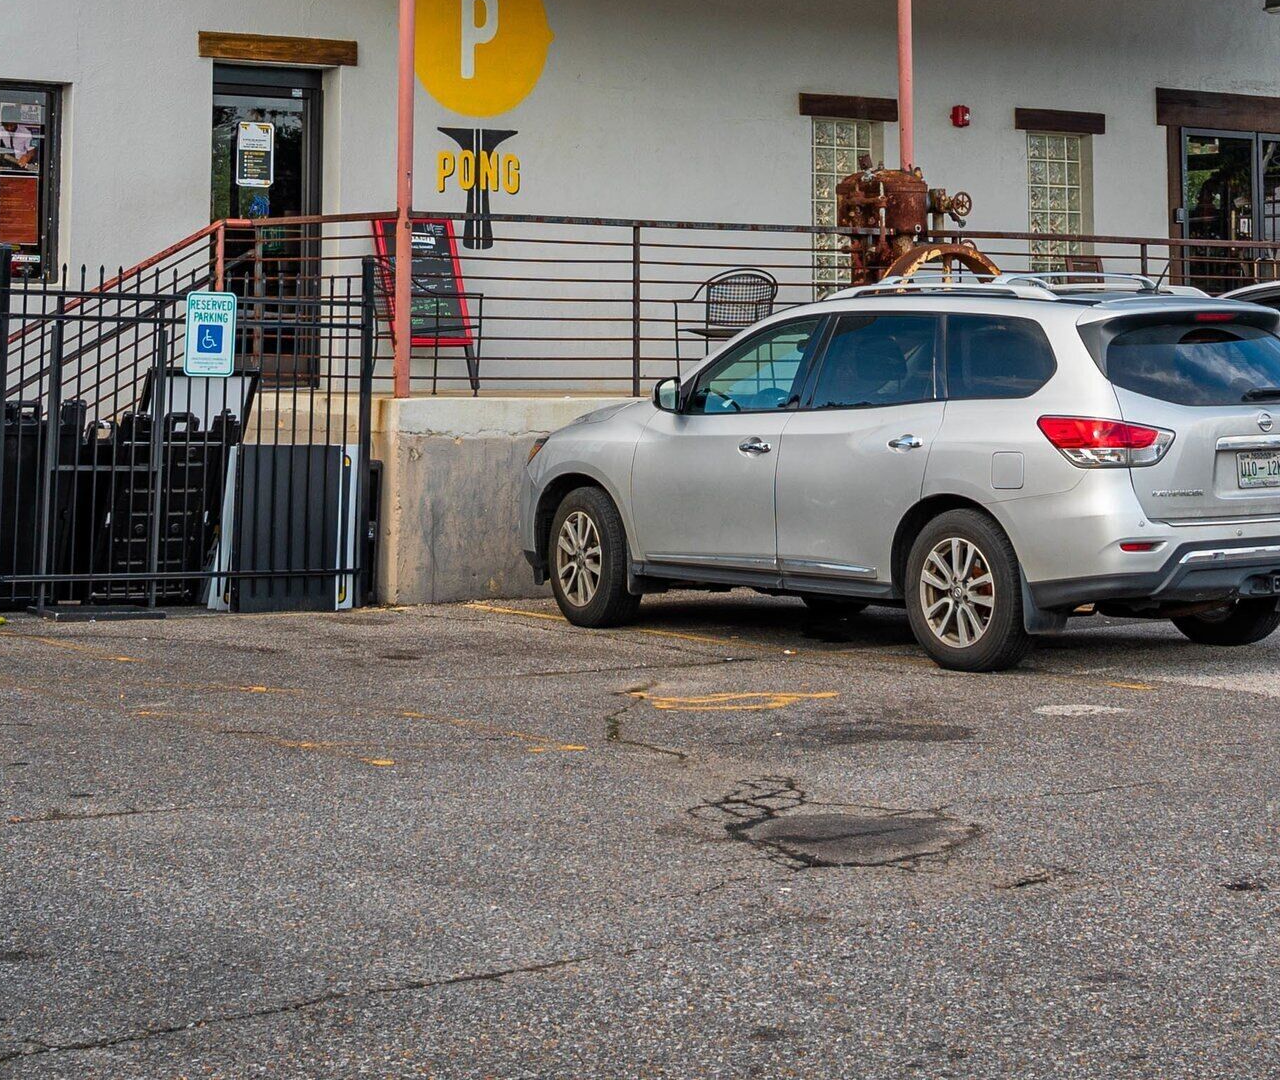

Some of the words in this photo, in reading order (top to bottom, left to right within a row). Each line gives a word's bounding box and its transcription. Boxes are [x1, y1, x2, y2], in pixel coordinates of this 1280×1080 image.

[436, 150, 521, 195] PONG
[190, 299, 233, 312] RESERVED
[193, 311, 229, 324] PARKING
